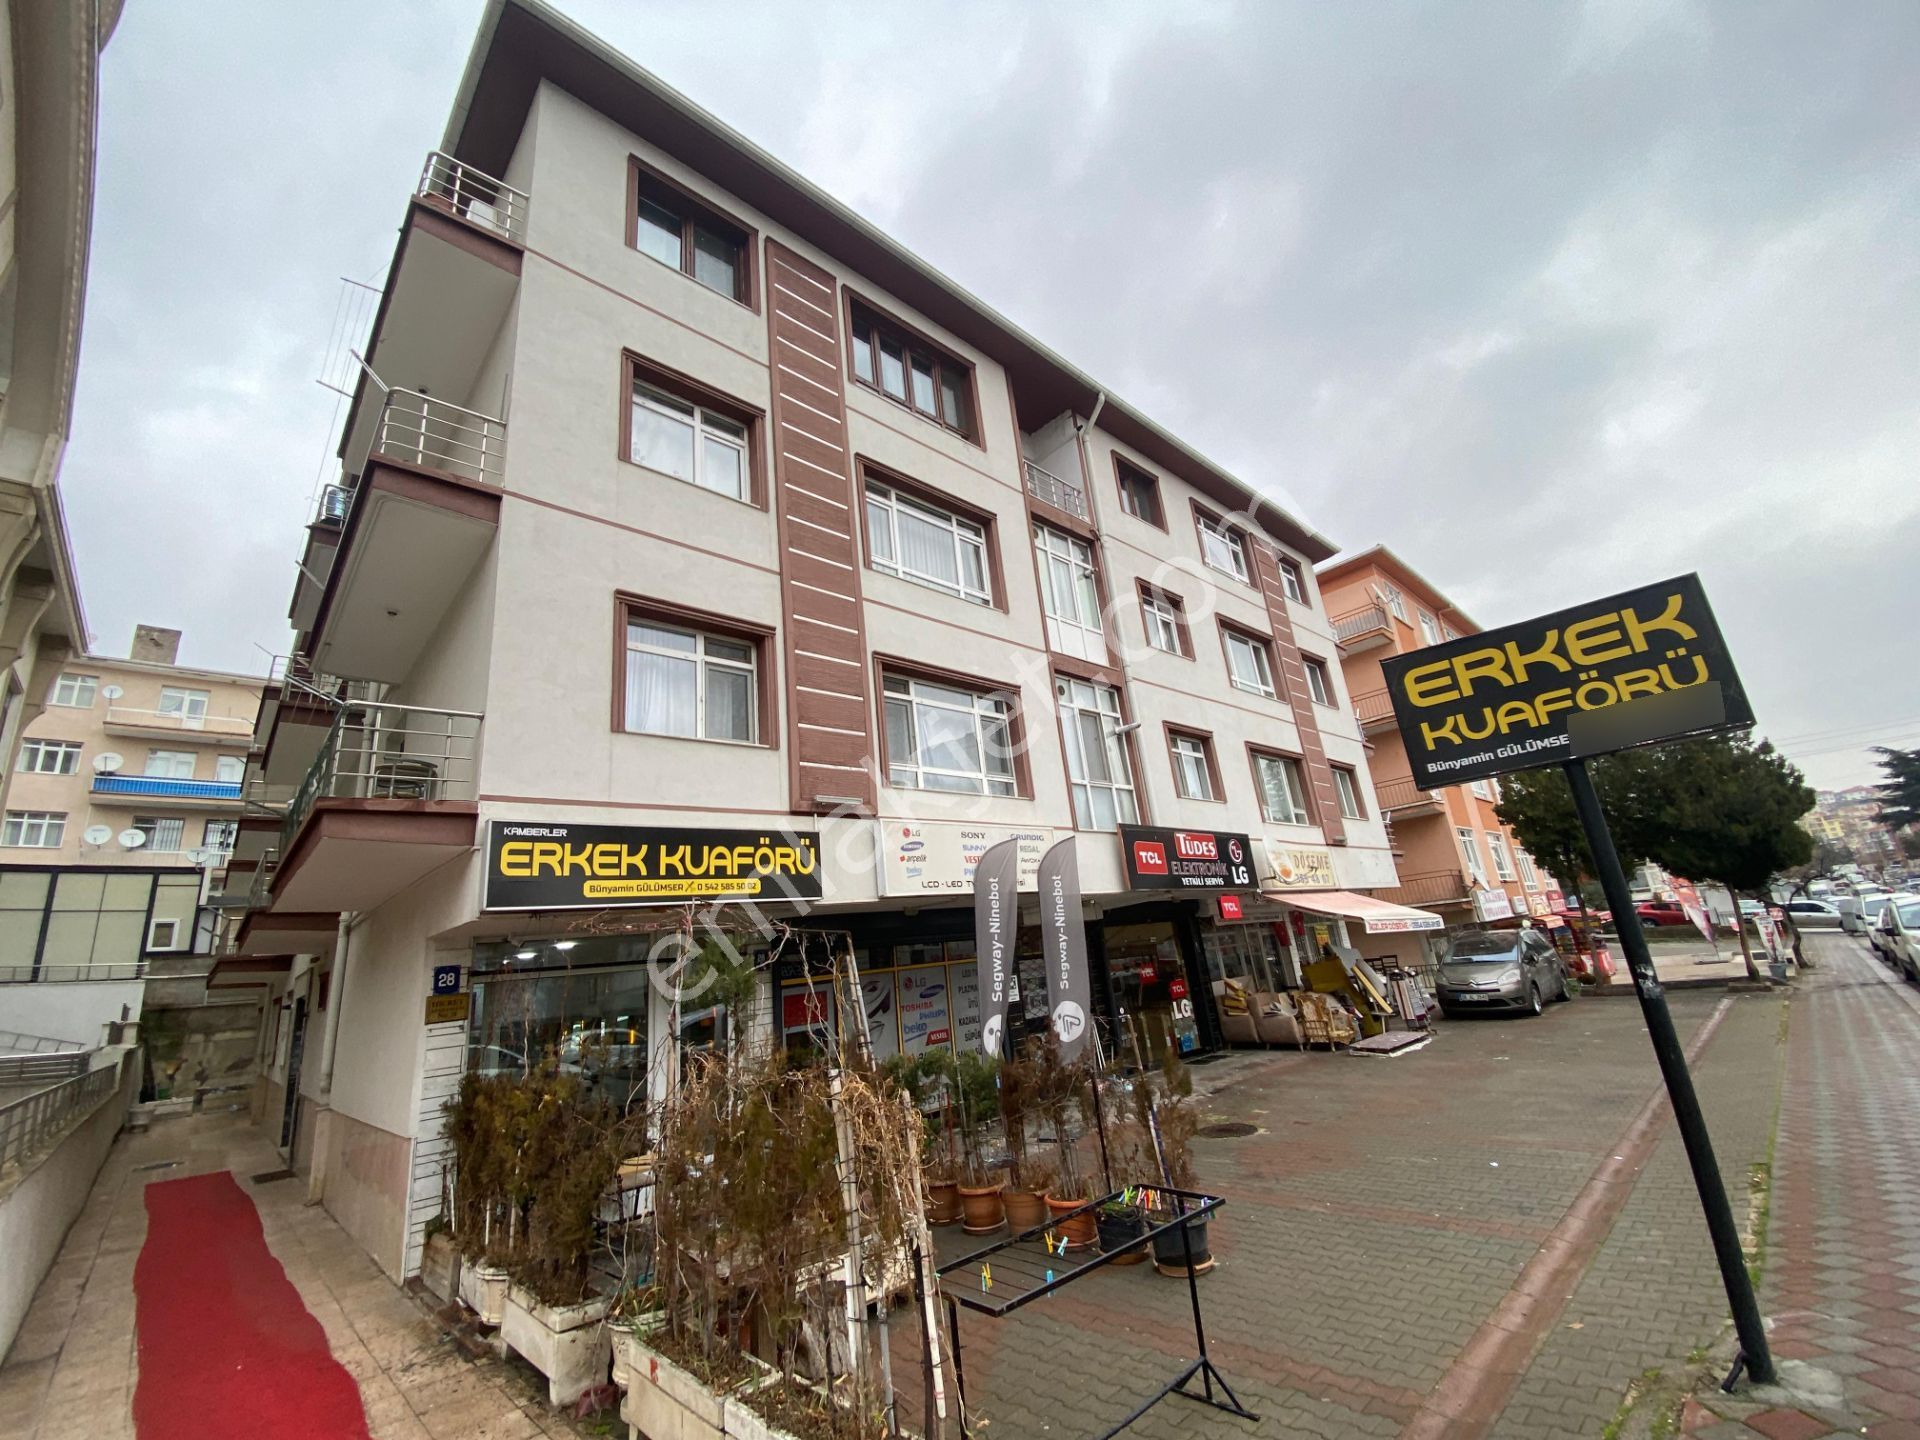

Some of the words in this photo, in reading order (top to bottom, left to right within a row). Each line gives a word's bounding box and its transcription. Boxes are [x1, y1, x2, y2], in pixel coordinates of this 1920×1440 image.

[1403, 593, 1698, 708] ERKEK
[1420, 647, 1710, 751] KUAFÖRÜ
[1427, 751, 1495, 774] Bünyamin
[1496, 734, 1570, 759] GÜLÜMSE
[503, 826, 568, 837] KAMBERLER
[960, 831, 986, 839] SONY
[1175, 833, 1216, 857] TÜDEŞ
[500, 841, 648, 877] ERKEK
[660, 837, 817, 876] KUAFÖRÜ
[964, 855, 982, 864] VEST
[1139, 851, 1163, 865] TCL
[1171, 860, 1229, 876] ELEKTRONİK
[1231, 865, 1250, 884] LG
[589, 884, 635, 894] Bünyamin
[636, 882, 684, 892] GÜLÜMSER
[704, 883, 719, 891] 542
[921, 881, 940, 889] LCD
[945, 880, 963, 888] LED
[1223, 902, 1239, 912] TCL
[1051, 874, 1070, 990] Segway-Ninebot
[988, 877, 1005, 1002] Segway-Ninebot
[438, 972, 455, 987] 28
[914, 976, 927, 988] LG
[1171, 985, 1185, 993] TCL
[900, 1000, 935, 1013] TOSHIBA
[1173, 999, 1191, 1020] LG
[903, 1021, 928, 1034] beko
